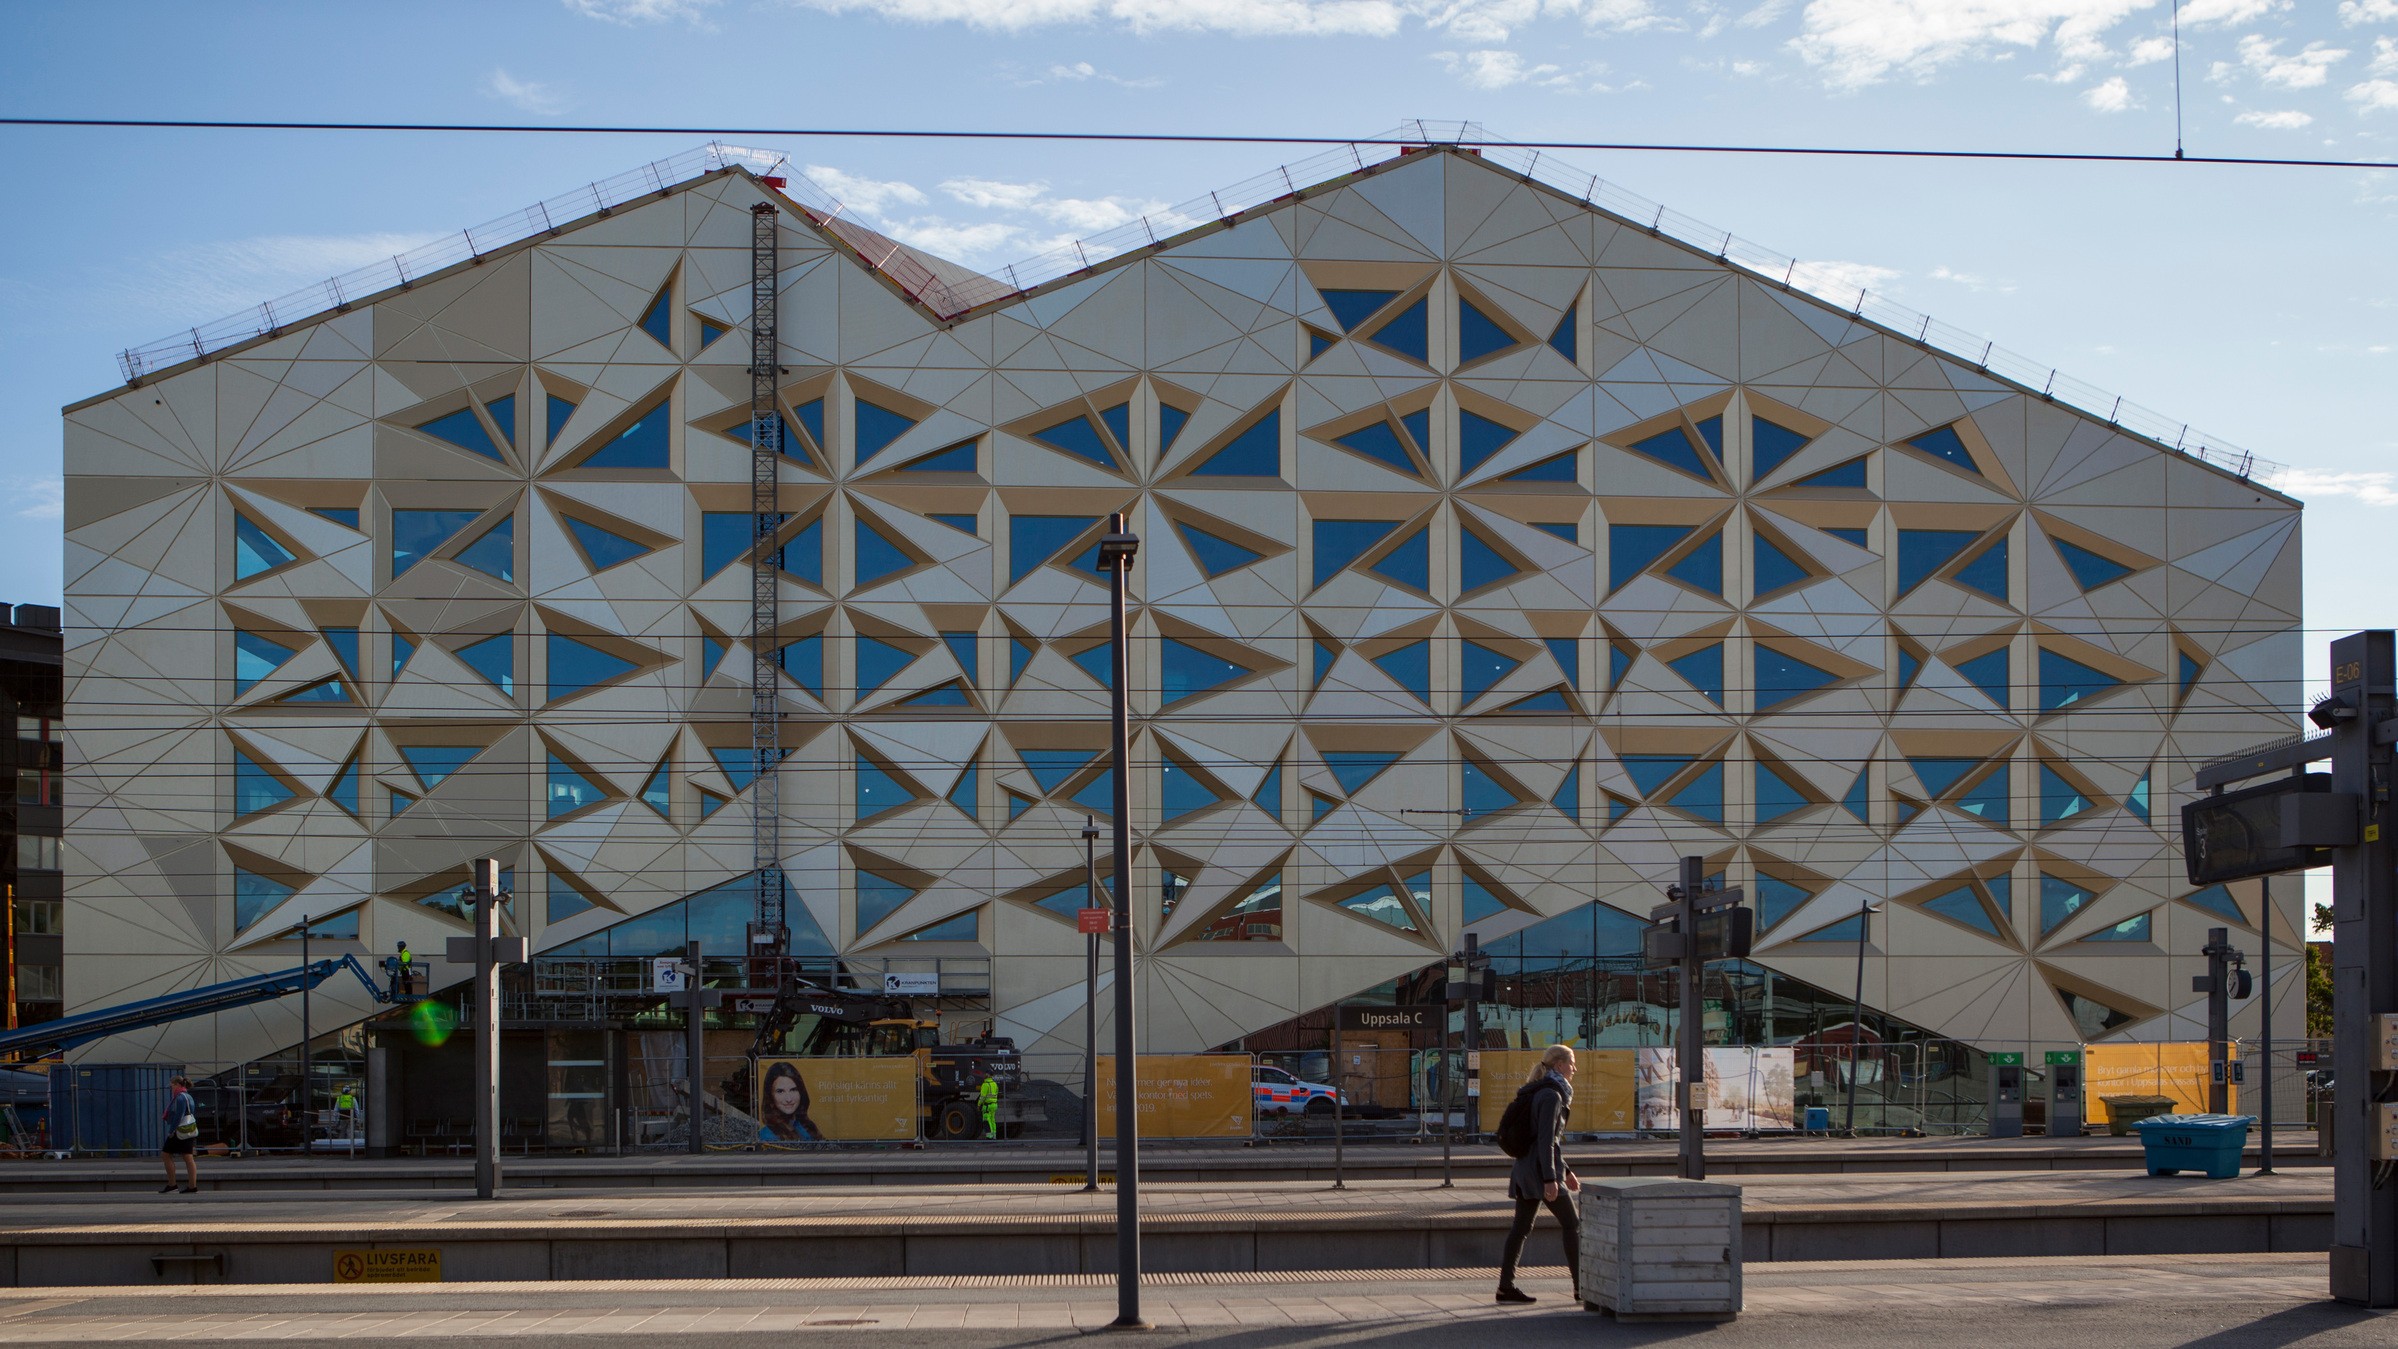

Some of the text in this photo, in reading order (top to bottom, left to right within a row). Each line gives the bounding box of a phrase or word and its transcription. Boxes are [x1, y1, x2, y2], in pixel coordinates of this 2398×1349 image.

[2336, 661, 2360, 684] E-06
[2200, 838, 2206, 859] 3
[811, 1004, 843, 1015] VOLVO
[1361, 1011, 1423, 1028] Uppsala C
[990, 1063, 1016, 1071] VOLVO
[2098, 1066, 2114, 1075] Bryt
[2179, 1064, 2195, 1073] och
[1157, 1079, 1171, 1089] ger
[1173, 1079, 1188, 1089] nya
[2131, 1079, 2167, 1088] Uppsaas
[1138, 1091, 1166, 1100] kontor
[2164, 1136, 2192, 1146] SAND
[366, 1252, 437, 1265] LIVSFARA
